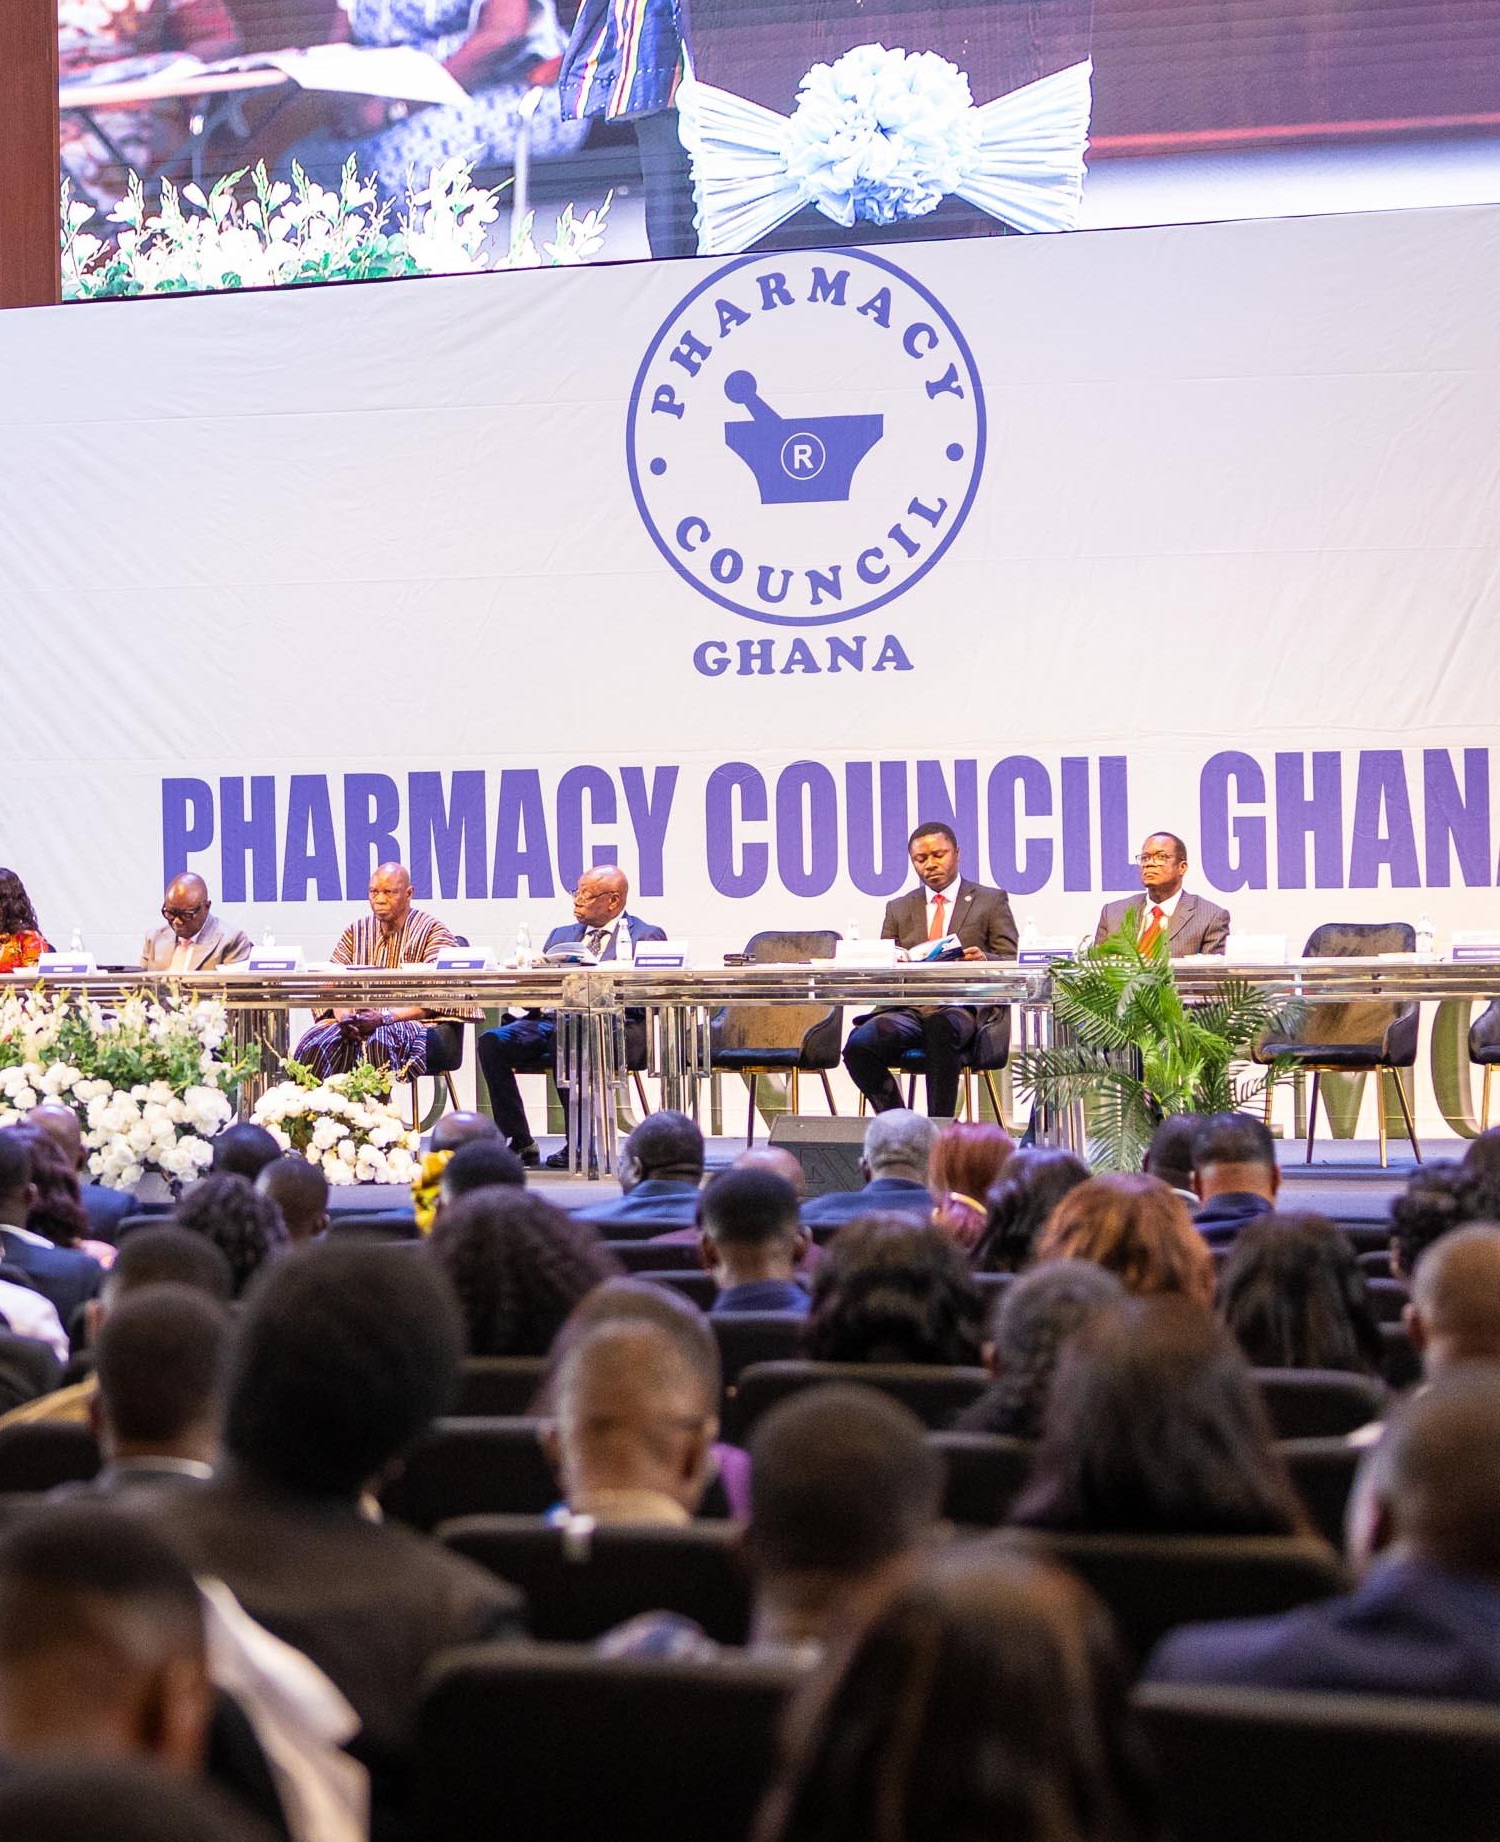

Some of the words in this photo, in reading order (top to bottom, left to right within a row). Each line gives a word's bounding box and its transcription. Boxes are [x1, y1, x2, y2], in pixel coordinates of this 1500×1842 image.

[650, 267, 965, 420] PHARMACY
[675, 496, 948, 606] COUNCIL
[693, 634, 915, 677] GHANA
[161, 764, 679, 903] PHARMACY
[705, 755, 1146, 899] COUNCIL
[1199, 747, 1500, 894] GHAN
